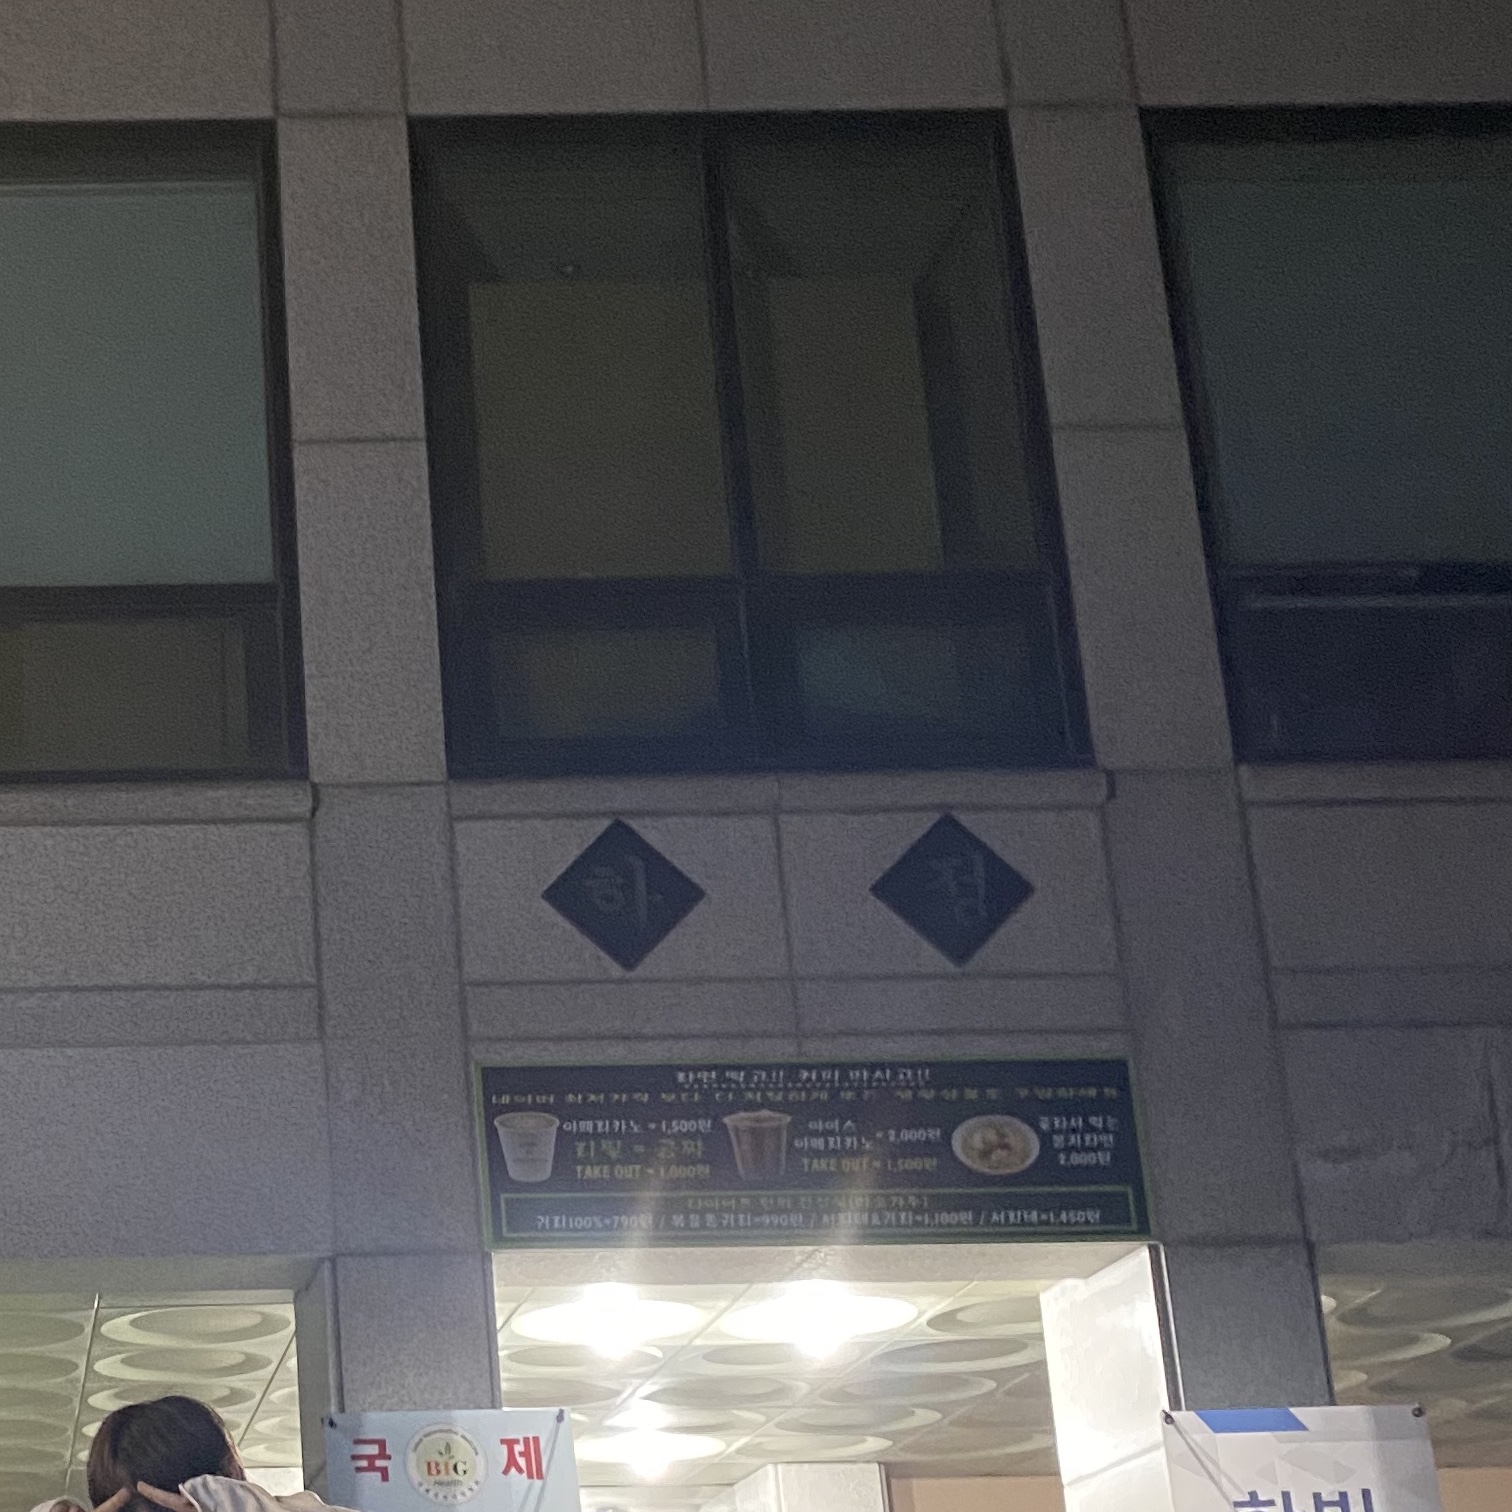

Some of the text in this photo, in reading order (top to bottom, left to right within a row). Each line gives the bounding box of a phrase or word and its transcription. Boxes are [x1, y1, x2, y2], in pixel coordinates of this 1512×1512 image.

[563, 1119, 641, 1134] 아메리카노
[794, 1135, 873, 1151] 아메리카노
[575, 1165, 610, 1180] TAKE
[614, 1164, 642, 1180] OUT
[801, 1157, 838, 1173] TAKE
[841, 1157, 870, 1173] OUT
[350, 1437, 392, 1482] 국
[500, 1435, 545, 1481] 제
